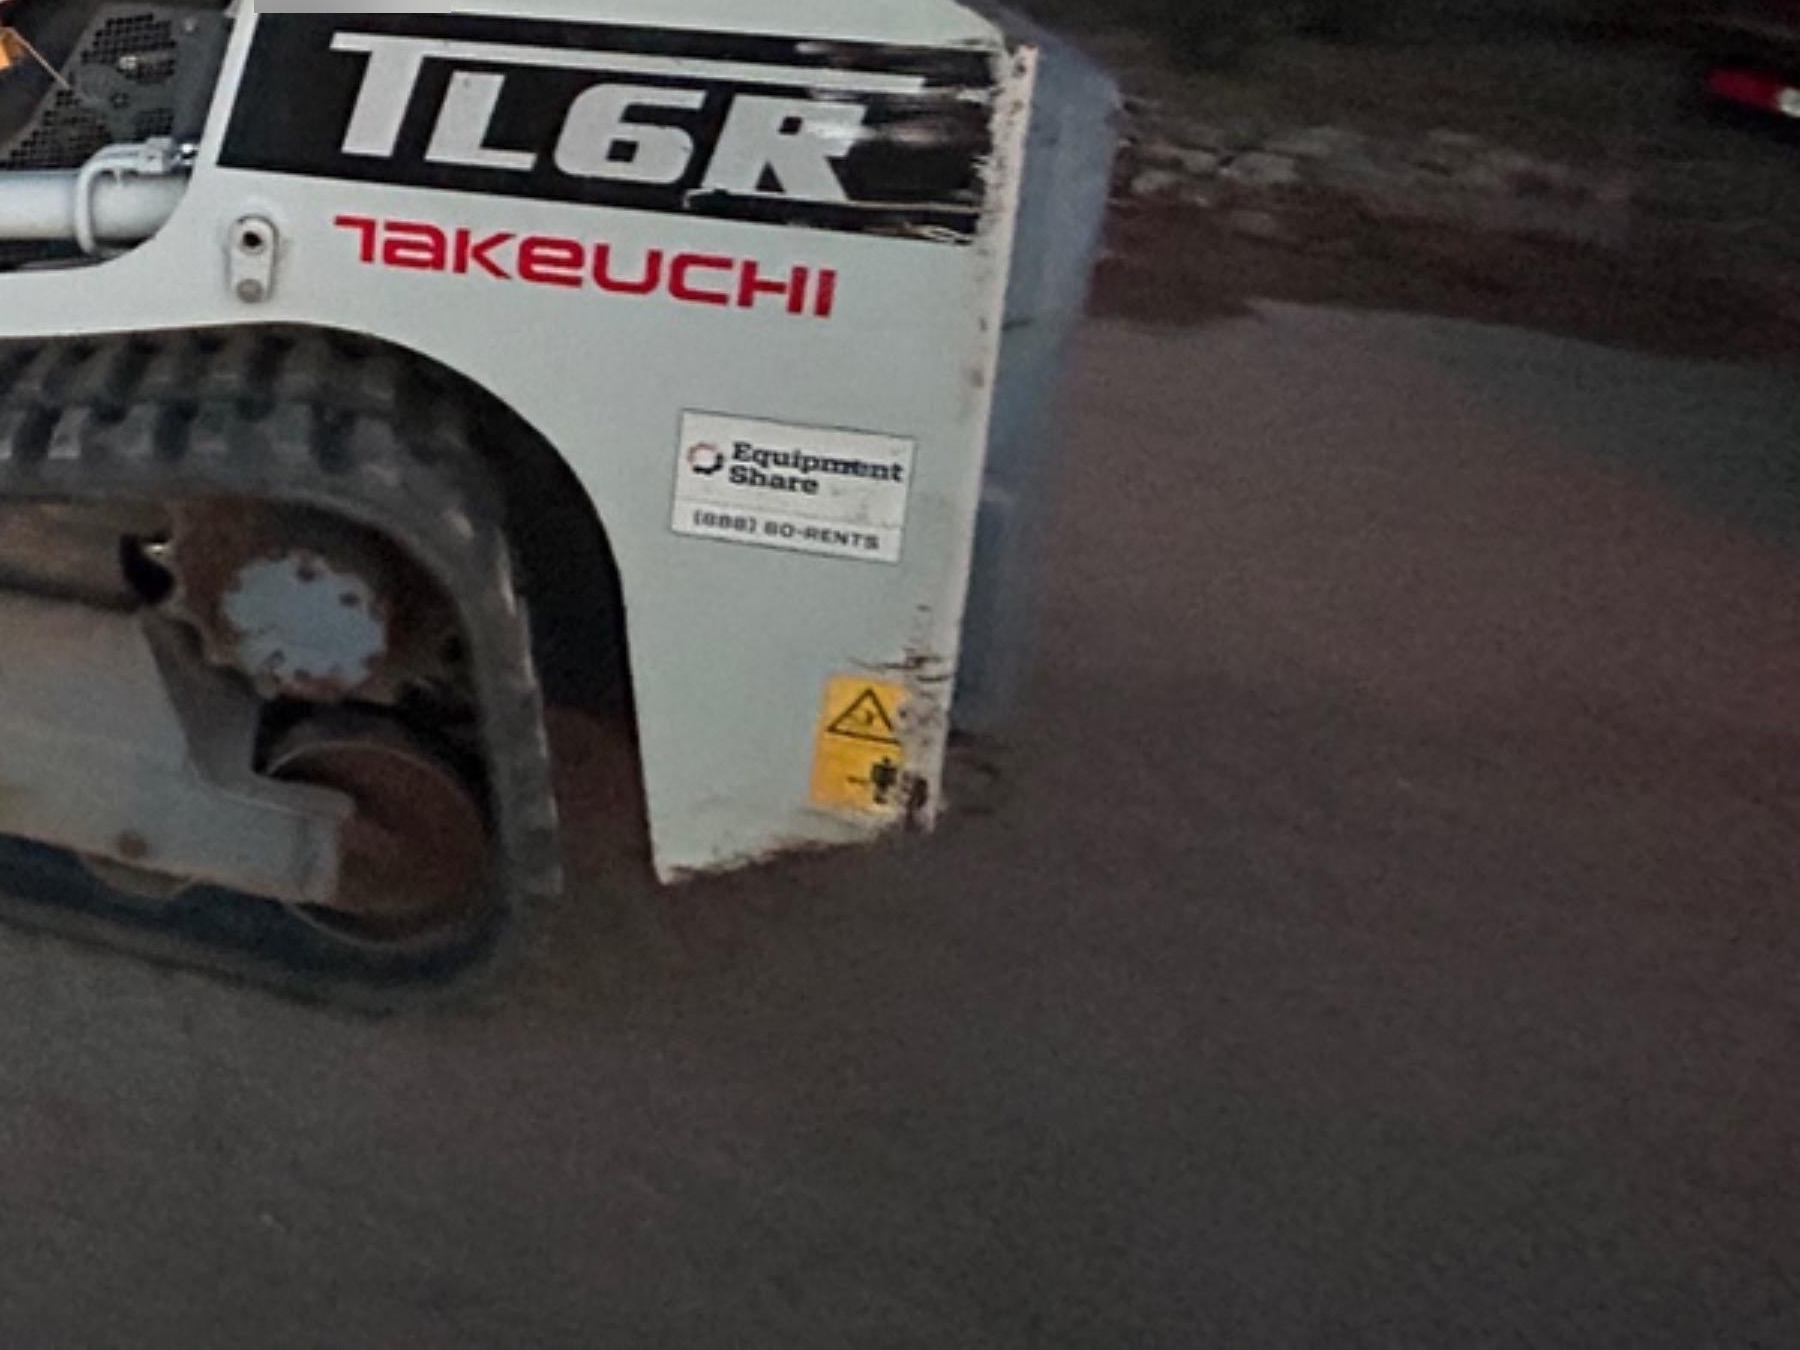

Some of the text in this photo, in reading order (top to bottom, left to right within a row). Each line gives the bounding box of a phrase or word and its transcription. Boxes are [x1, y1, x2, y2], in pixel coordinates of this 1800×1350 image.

[330, 31, 926, 202] TL6R
[729, 465, 820, 495] Share
[731, 441, 904, 482] Equipment
